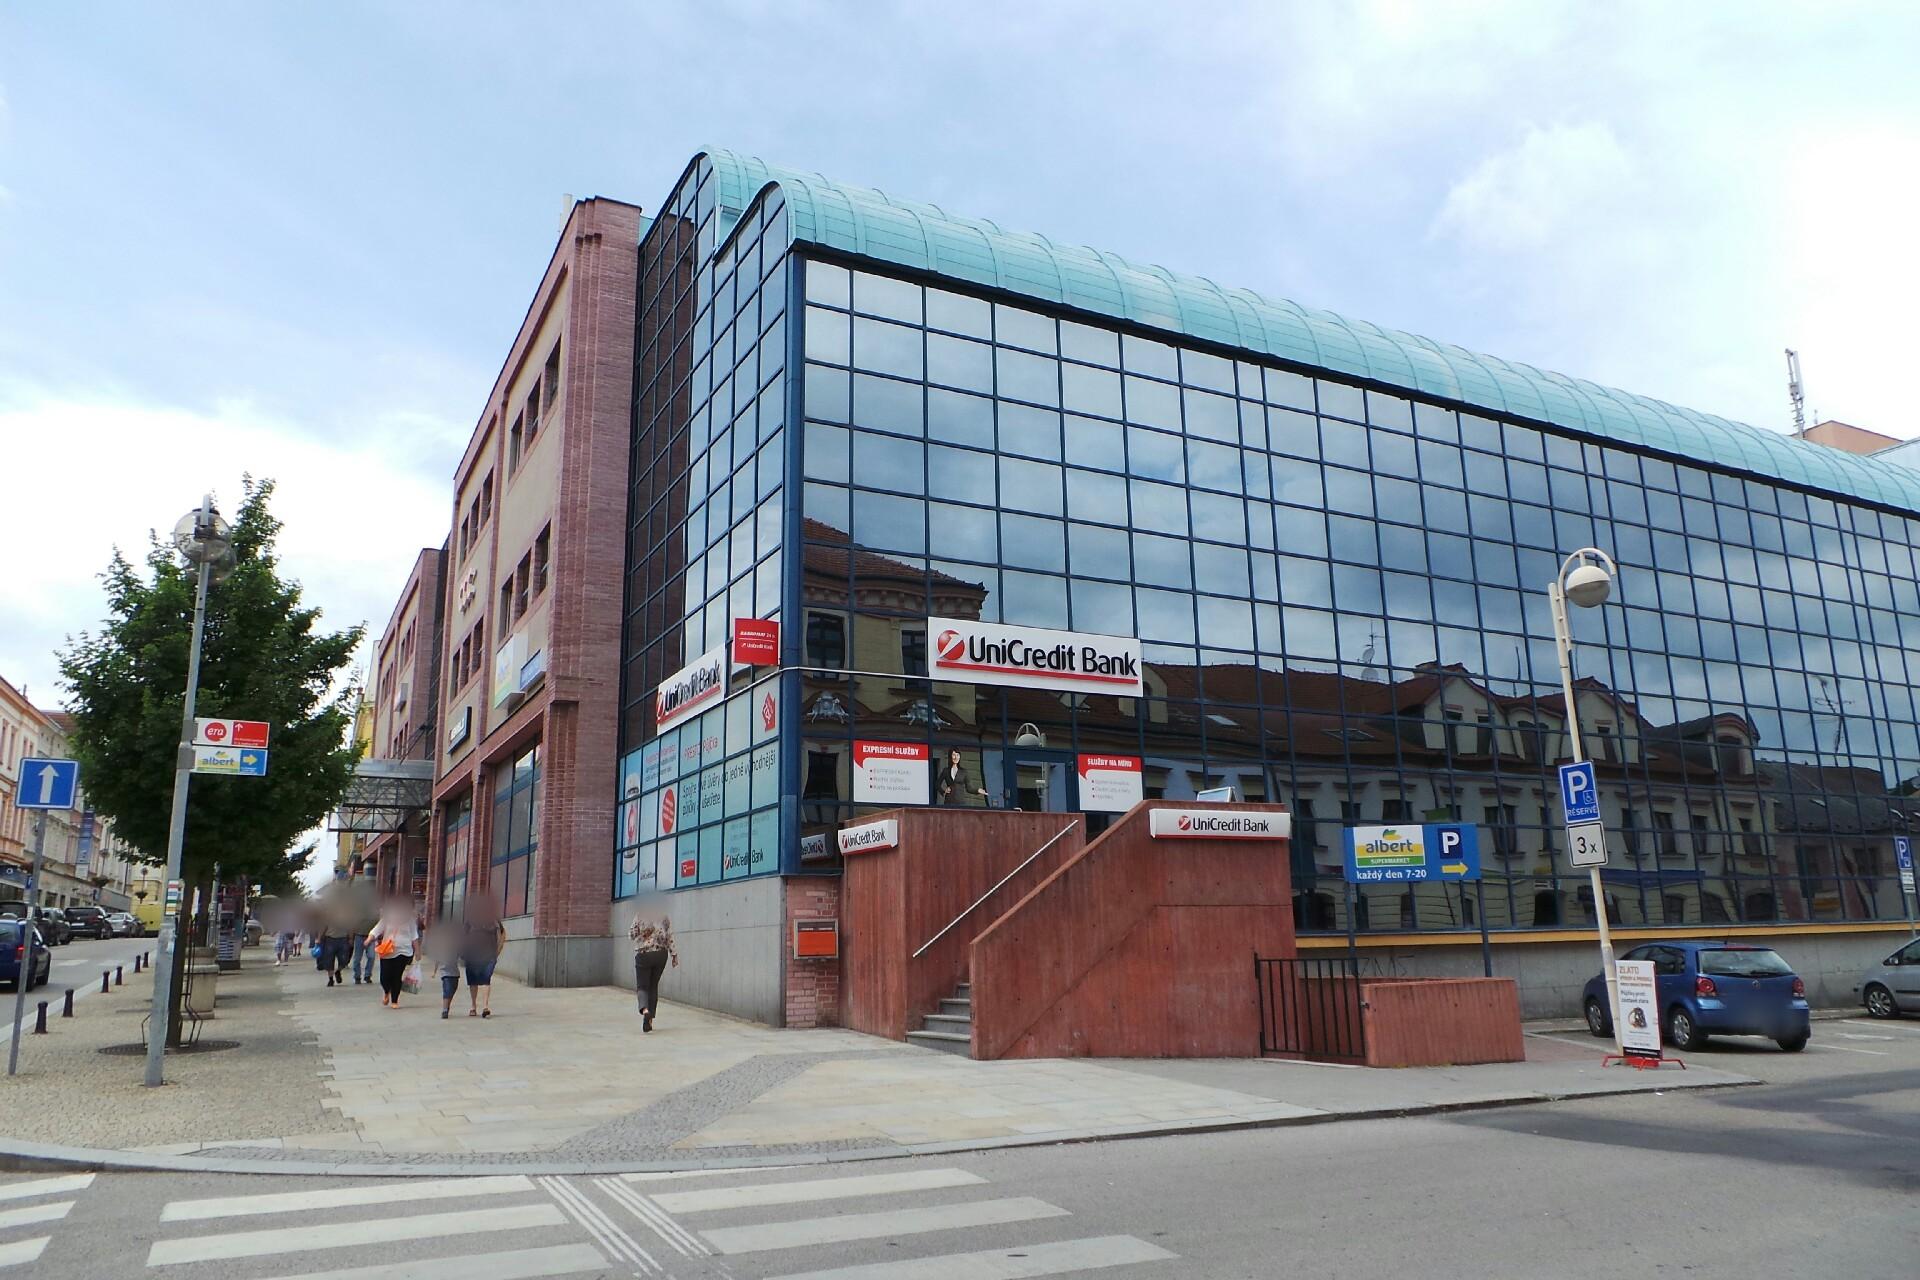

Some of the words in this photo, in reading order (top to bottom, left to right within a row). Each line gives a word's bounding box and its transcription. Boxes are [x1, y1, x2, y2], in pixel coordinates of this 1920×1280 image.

[969, 635, 1076, 671] UniCredit
[1082, 646, 1138, 677] Bank
[664, 671, 699, 712] UniCredit
[699, 659, 720, 693] Bank
[207, 727, 224, 736] era
[862, 745, 894, 755] EXPRESNÍ
[894, 746, 920, 756] SLUŽBY
[202, 756, 235, 766] albert
[1087, 757, 1108, 766] SLUŽBY
[1567, 770, 1588, 805] P
[1192, 817, 1241, 832] UniCredit
[1243, 818, 1269, 832] Bank
[847, 830, 871, 847] UniCredit
[871, 827, 886, 843] Bank
[1366, 839, 1414, 854] albert
[1442, 831, 1460, 854] P
[1576, 836, 1587, 854] 3
[1590, 843, 1597, 854] x
[729, 851, 750, 869] UniCredi
[751, 847, 764, 864] Bank
[1370, 857, 1410, 865] SUPERMARKET
[1356, 870, 1383, 881] každý
[1385, 869, 1403, 879] den
[1406, 869, 1427, 878] 7-20
[1619, 965, 1639, 974] ZLATO
